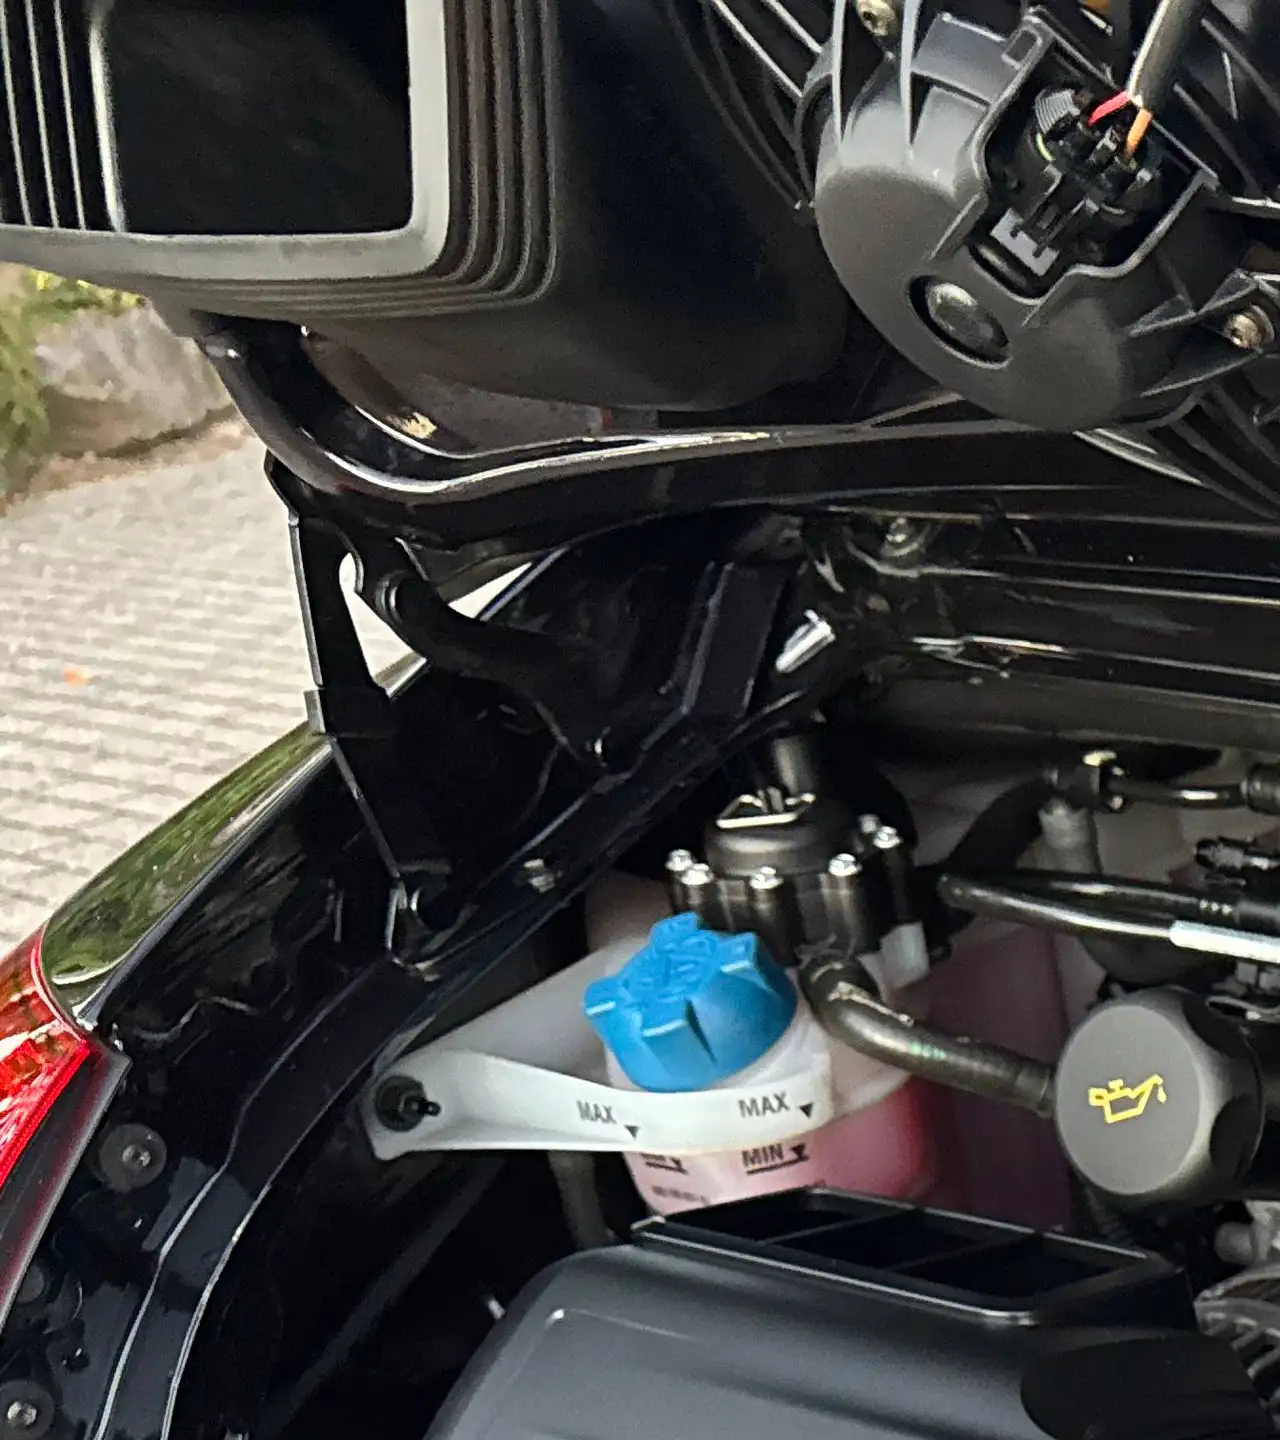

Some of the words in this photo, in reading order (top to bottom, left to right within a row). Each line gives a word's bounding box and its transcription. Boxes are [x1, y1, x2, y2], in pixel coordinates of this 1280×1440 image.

[576, 1100, 618, 1125] MAX
[738, 1091, 791, 1118] MAX
[742, 1143, 786, 1167] MIN
